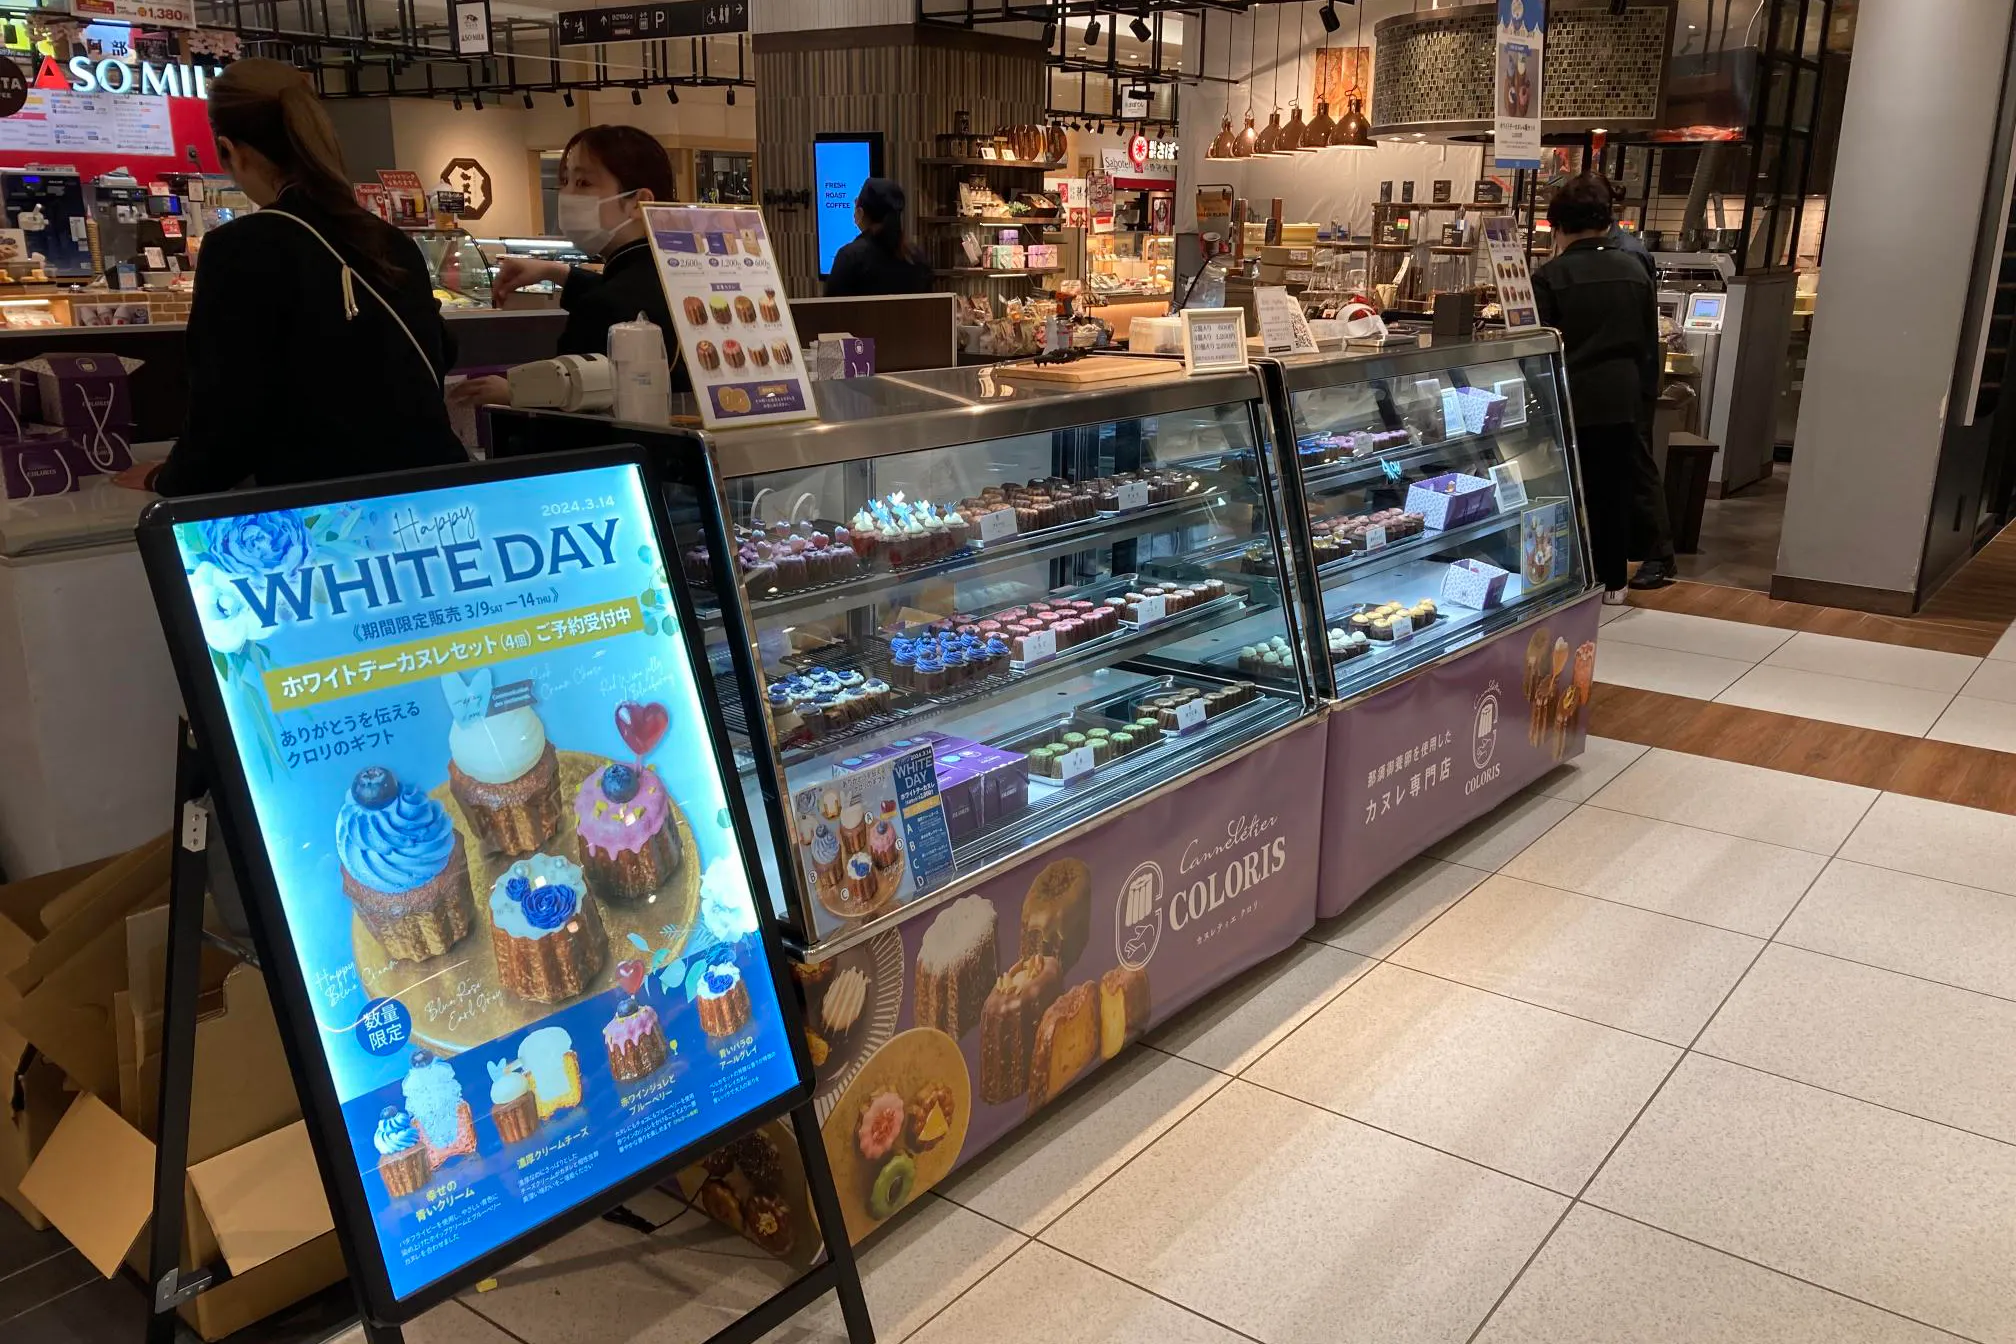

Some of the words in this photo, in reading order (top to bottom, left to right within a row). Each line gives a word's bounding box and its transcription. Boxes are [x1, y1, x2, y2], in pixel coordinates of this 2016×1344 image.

[35, 55, 133, 94] ASO
[141, 61, 222, 99] MIL
[541, 494, 616, 518] 2024.3.14
[392, 505, 476, 551] Happy
[229, 541, 493, 629] WHITE
[493, 517, 621, 584] DAY
[280, 698, 421, 749] ありがとうを伝える
[285, 730, 395, 769] クロリのギフト
[894, 755, 933, 779] WHITE
[904, 769, 927, 789] DAY
[1464, 762, 1501, 796] COLORIS
[1365, 756, 1452, 825] カヌレ専門店
[907, 824, 913, 834] A
[909, 841, 916, 851] B
[913, 858, 919, 869] C
[917, 875, 924, 886] D
[1169, 836, 1287, 931] COLORIS
[364, 1004, 399, 1030] 数量
[368, 1025, 405, 1051] 限定
[719, 1048, 758, 1071] アールグレイ
[620, 1074, 676, 1108] 赤ワインジュレと
[629, 1089, 673, 1115] ブルーベリー
[415, 1188, 475, 1223] 青いクリーム
